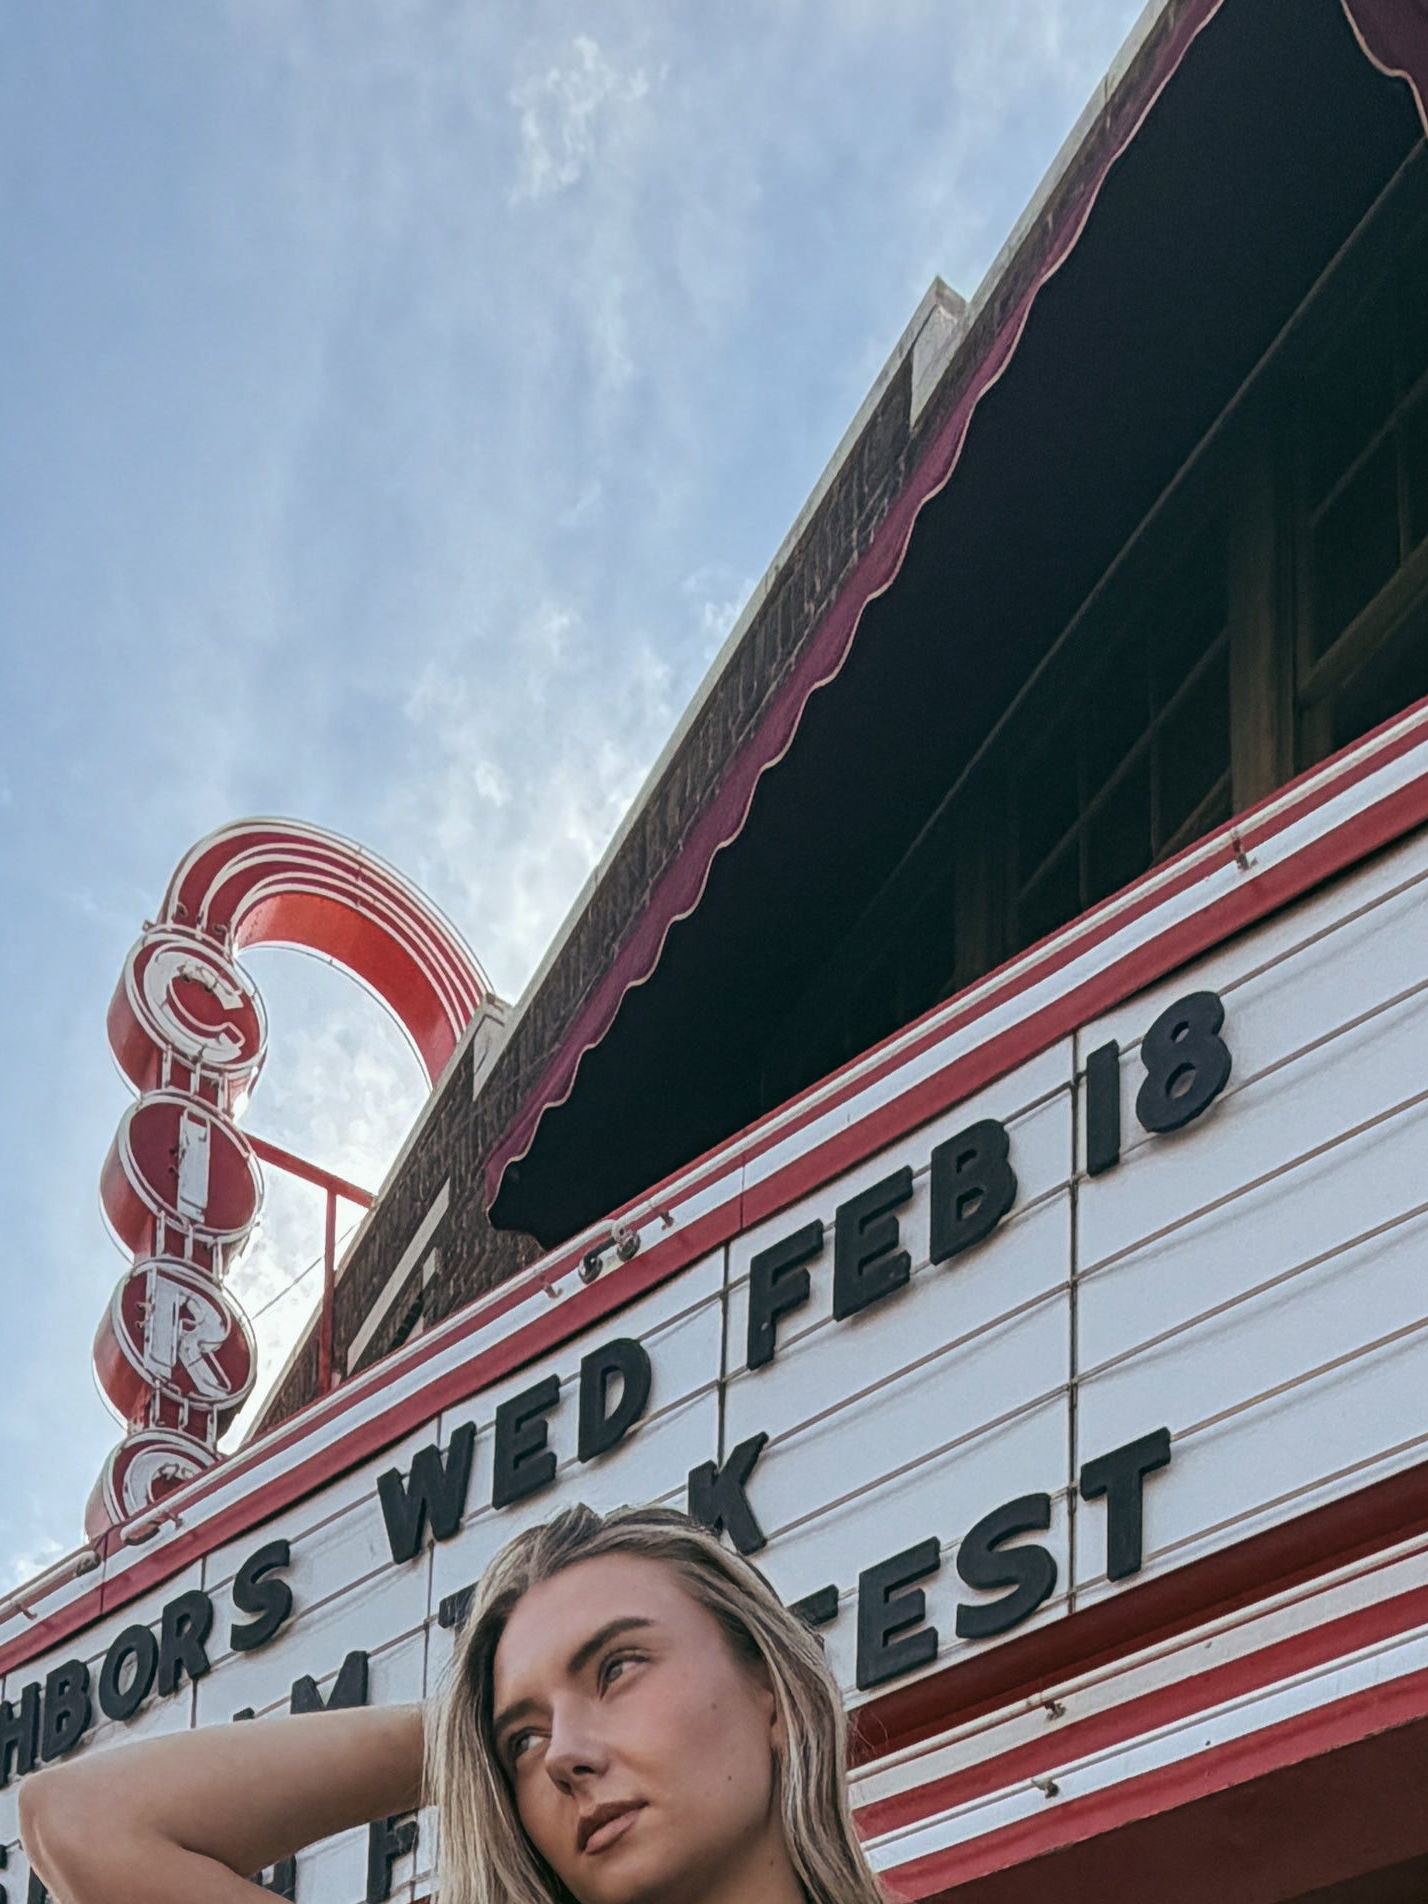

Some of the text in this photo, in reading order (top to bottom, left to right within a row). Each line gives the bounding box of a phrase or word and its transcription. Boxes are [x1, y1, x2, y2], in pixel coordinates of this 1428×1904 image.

[377, 1337, 652, 1565] WED
[746, 1117, 1019, 1370] FEB
[1085, 990, 1233, 1177] 18
